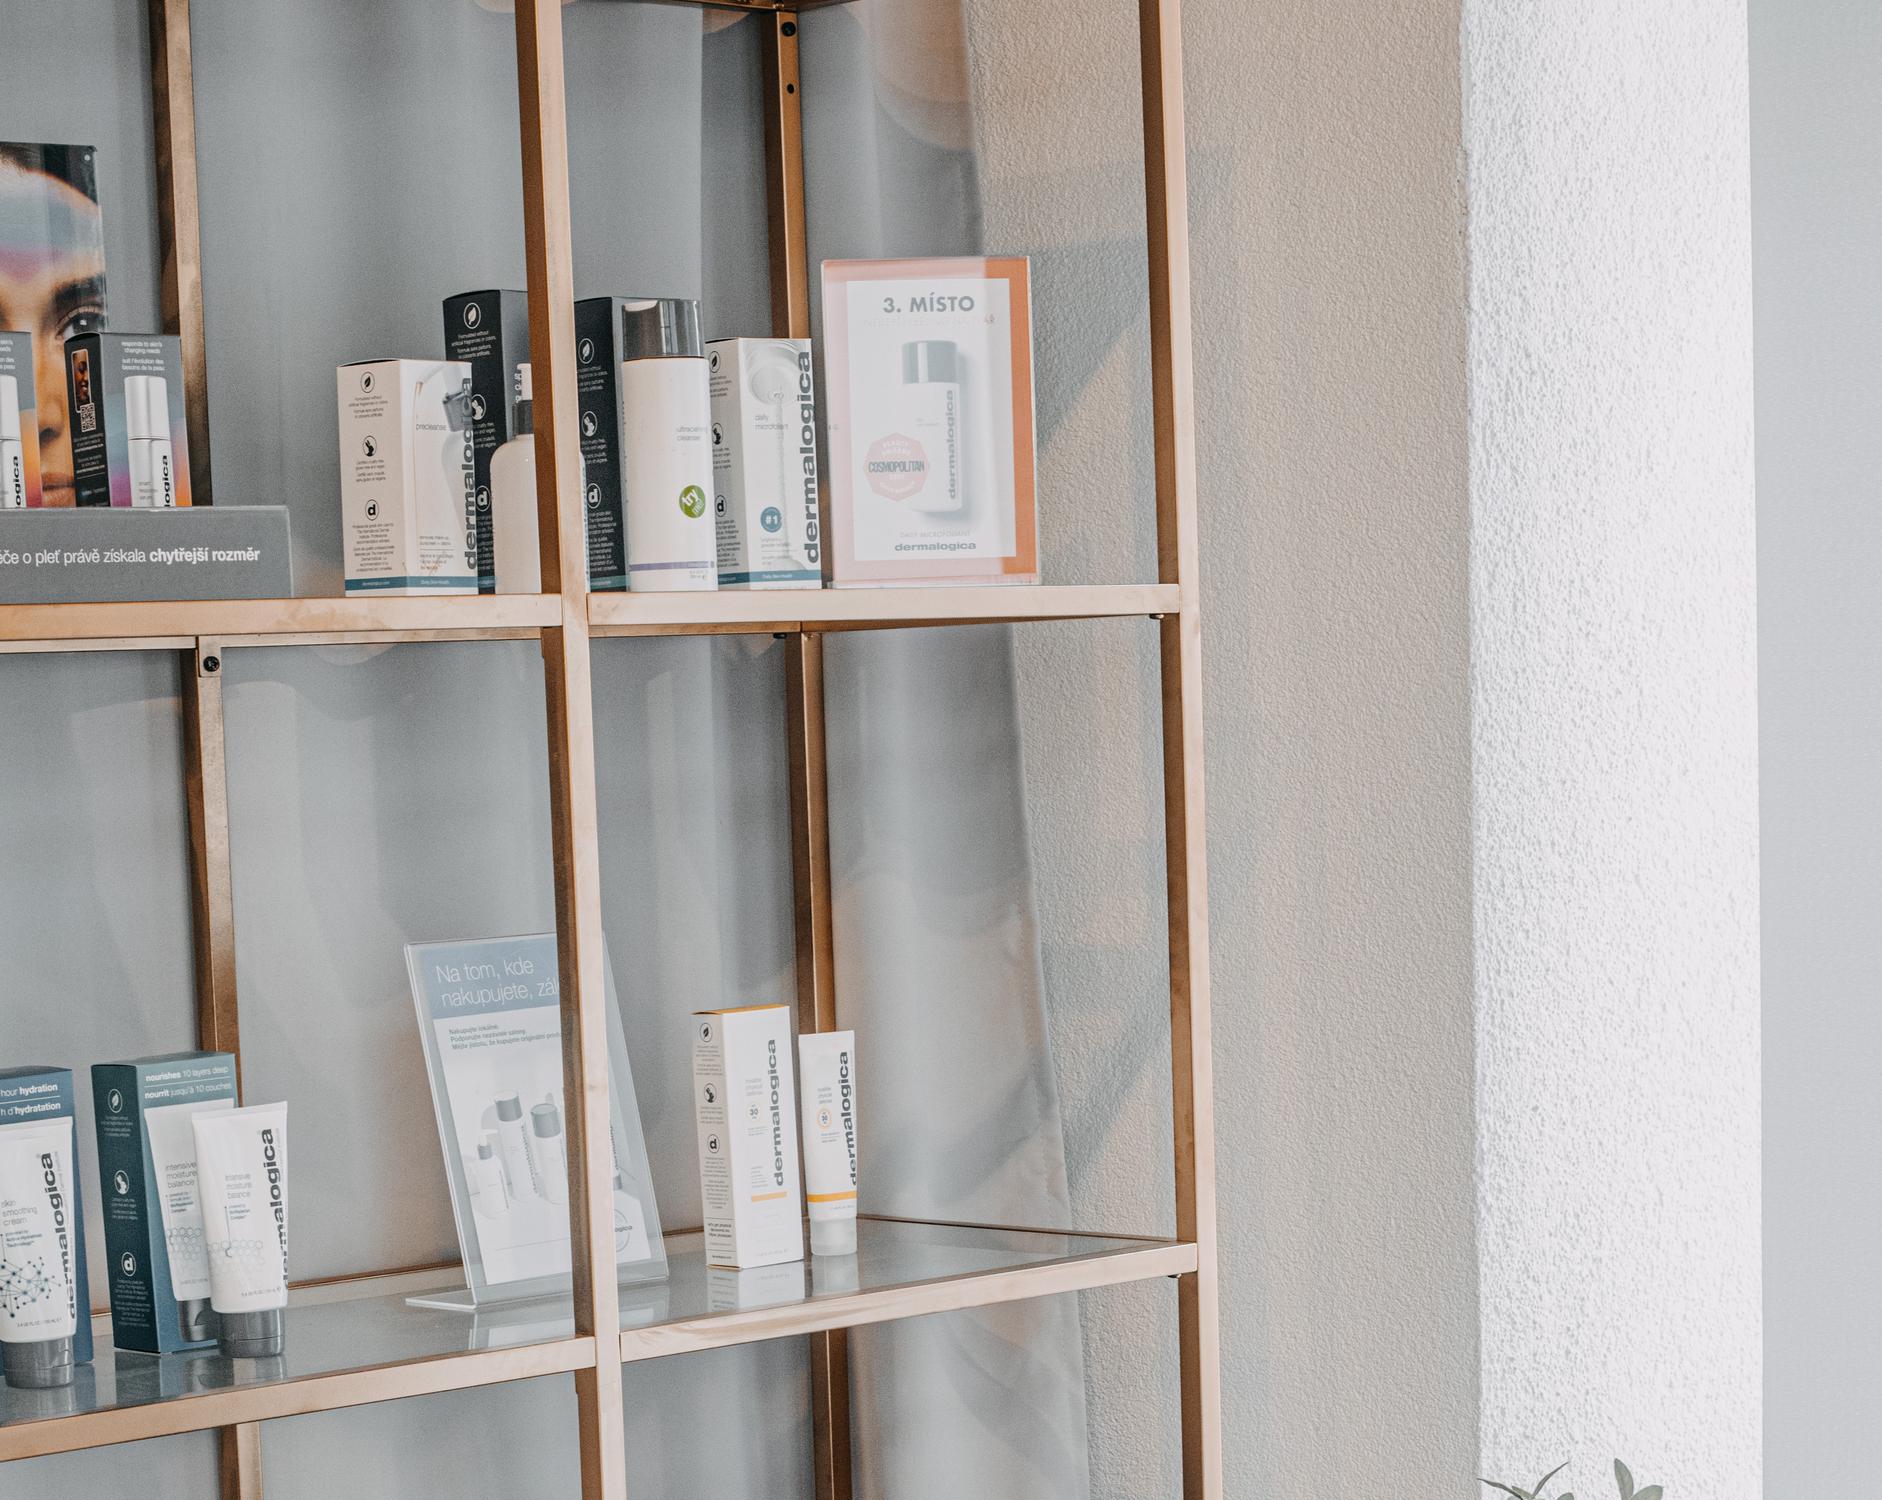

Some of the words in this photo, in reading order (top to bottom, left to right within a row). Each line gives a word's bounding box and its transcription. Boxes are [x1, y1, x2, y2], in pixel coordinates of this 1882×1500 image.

[882, 298, 902, 314] 3.
[909, 292, 975, 313] MÍSTO
[945, 389, 957, 501] dermalogica
[797, 351, 820, 564] dermalogica
[868, 460, 925, 473] COSMOPOLITAN
[682, 489, 699, 507] try
[765, 514, 778, 525] #1
[894, 541, 977, 552] dermalogica
[23, 552, 32, 564] o
[36, 549, 61, 566] pleť
[64, 548, 100, 566] právě
[103, 548, 146, 564] získala
[149, 547, 208, 565] chytřejší
[212, 548, 260, 562] rozměr
[435, 965, 461, 983] Na
[463, 963, 500, 981] tom,
[503, 956, 534, 976] kde
[441, 982, 533, 1007] nakupujete,
[145, 1071, 182, 1082] nourishes
[19, 1084, 58, 1096] hydration
[144, 1089, 170, 1099] nourrit
[767, 1039, 785, 1186] dermalogica
[838, 1052, 857, 1186] dermalogica
[2, 1206, 38, 1217] smoothing
[2, 1217, 28, 1226] cream
[41, 1152, 75, 1320] dermalogica
